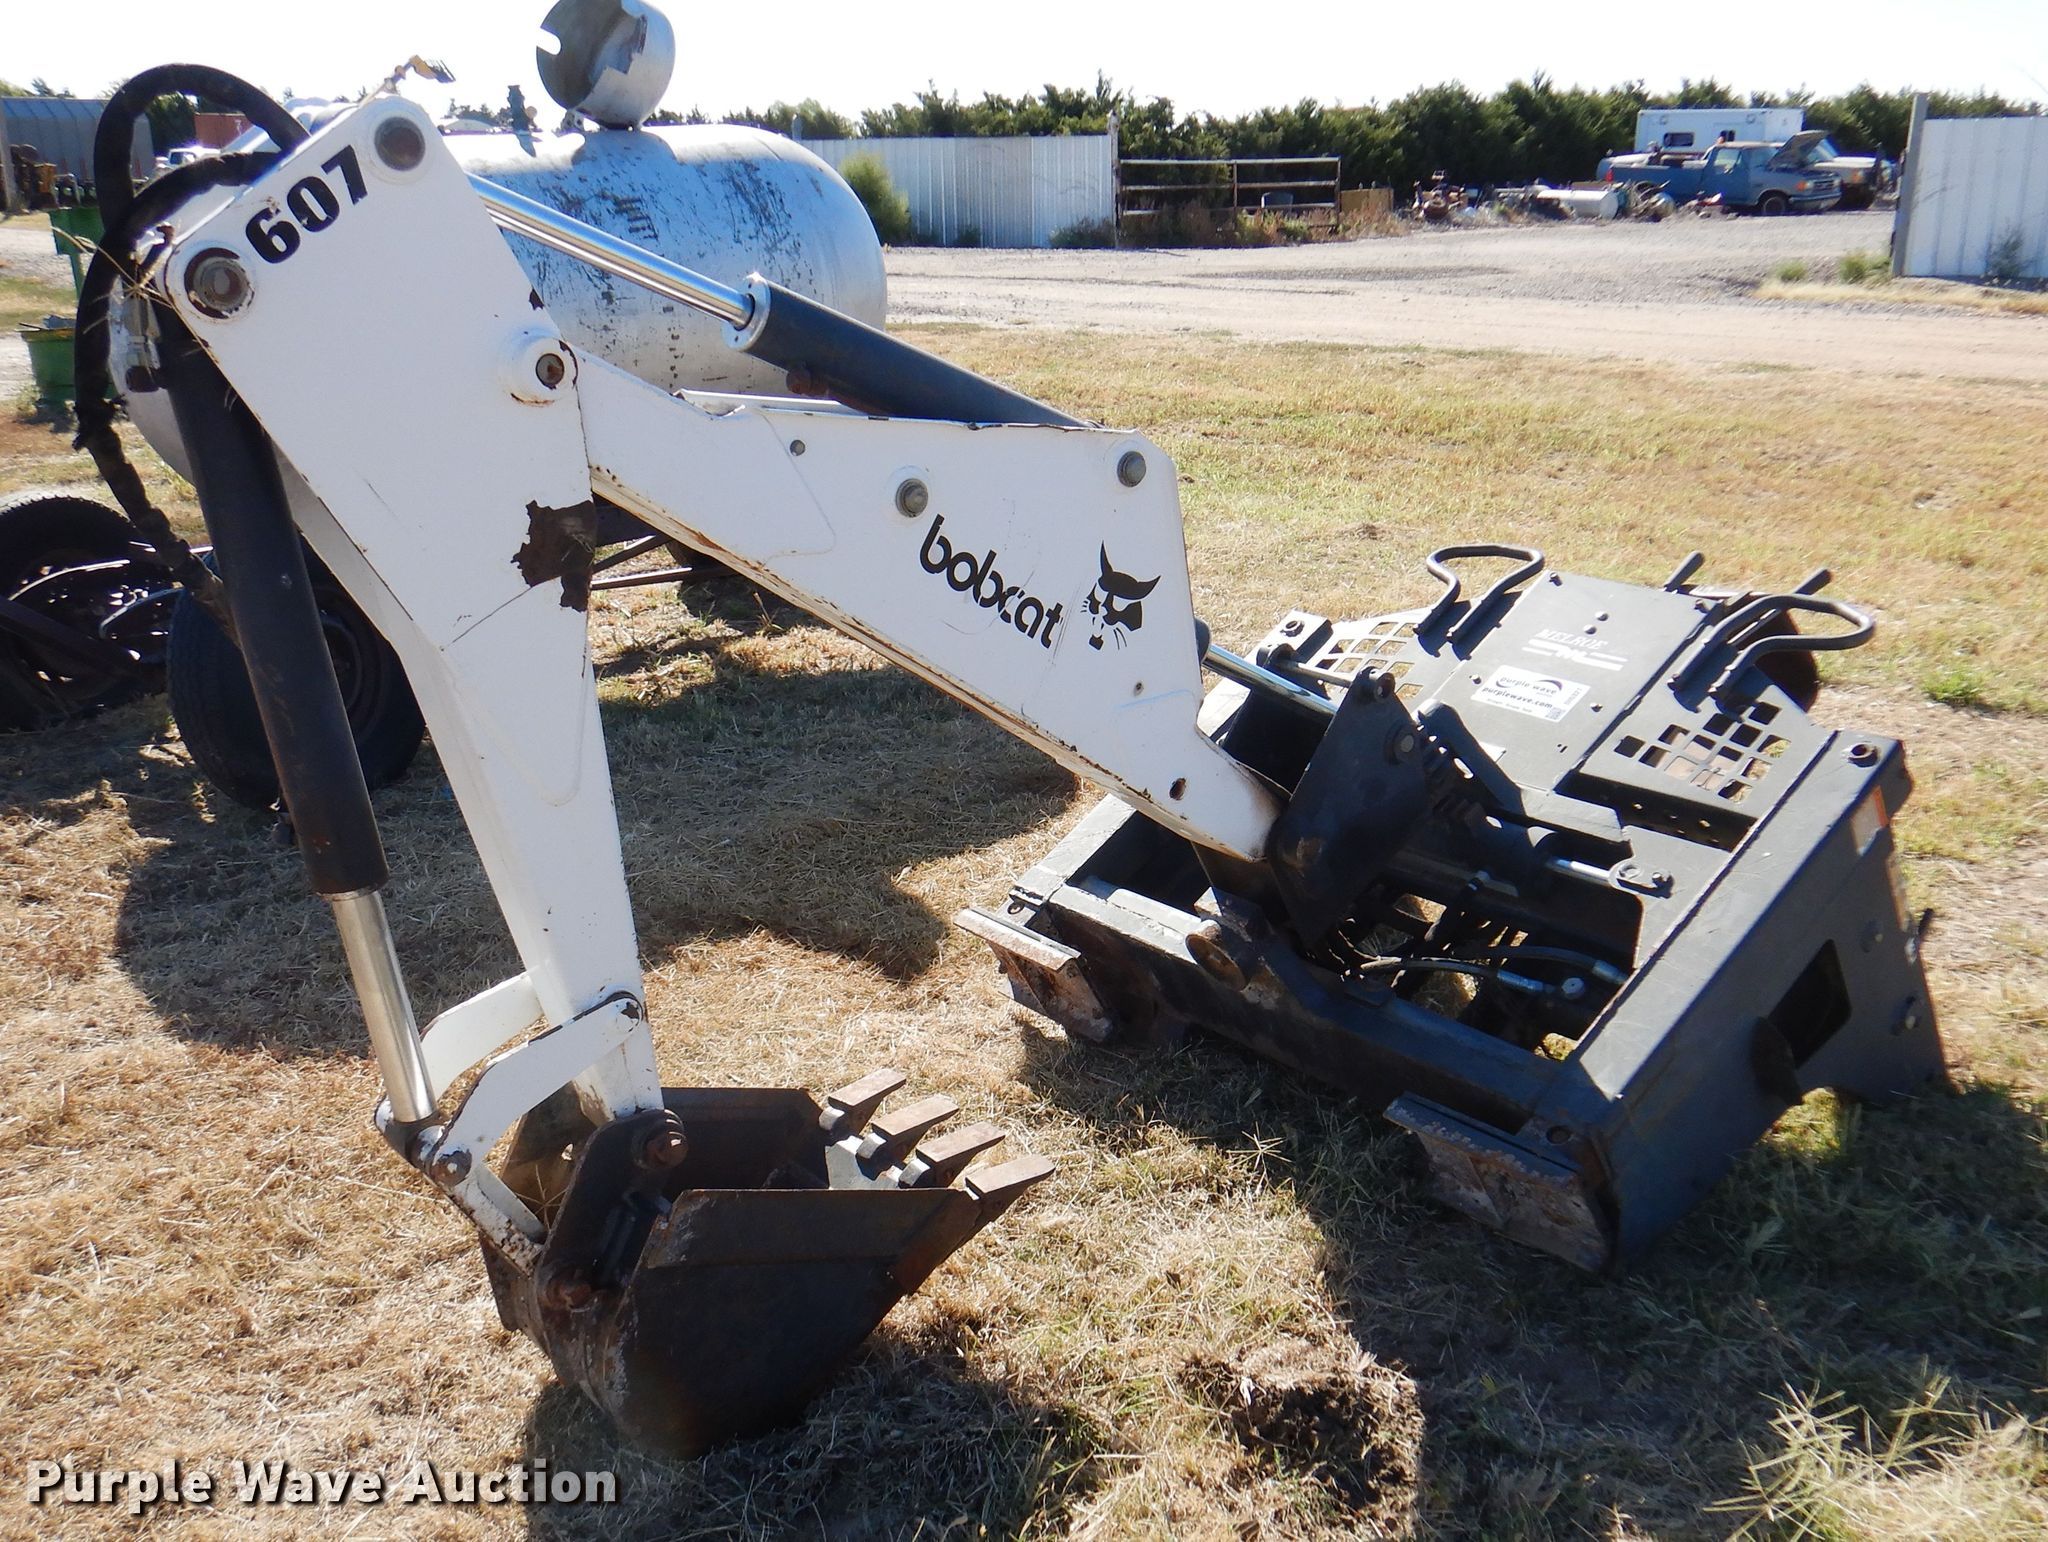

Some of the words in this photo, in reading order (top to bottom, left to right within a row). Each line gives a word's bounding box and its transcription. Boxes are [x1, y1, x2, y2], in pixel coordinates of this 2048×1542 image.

[245, 144, 368, 264] 607
[919, 513, 1063, 649] bobcat
[1482, 687, 1553, 708] purplewave.com
